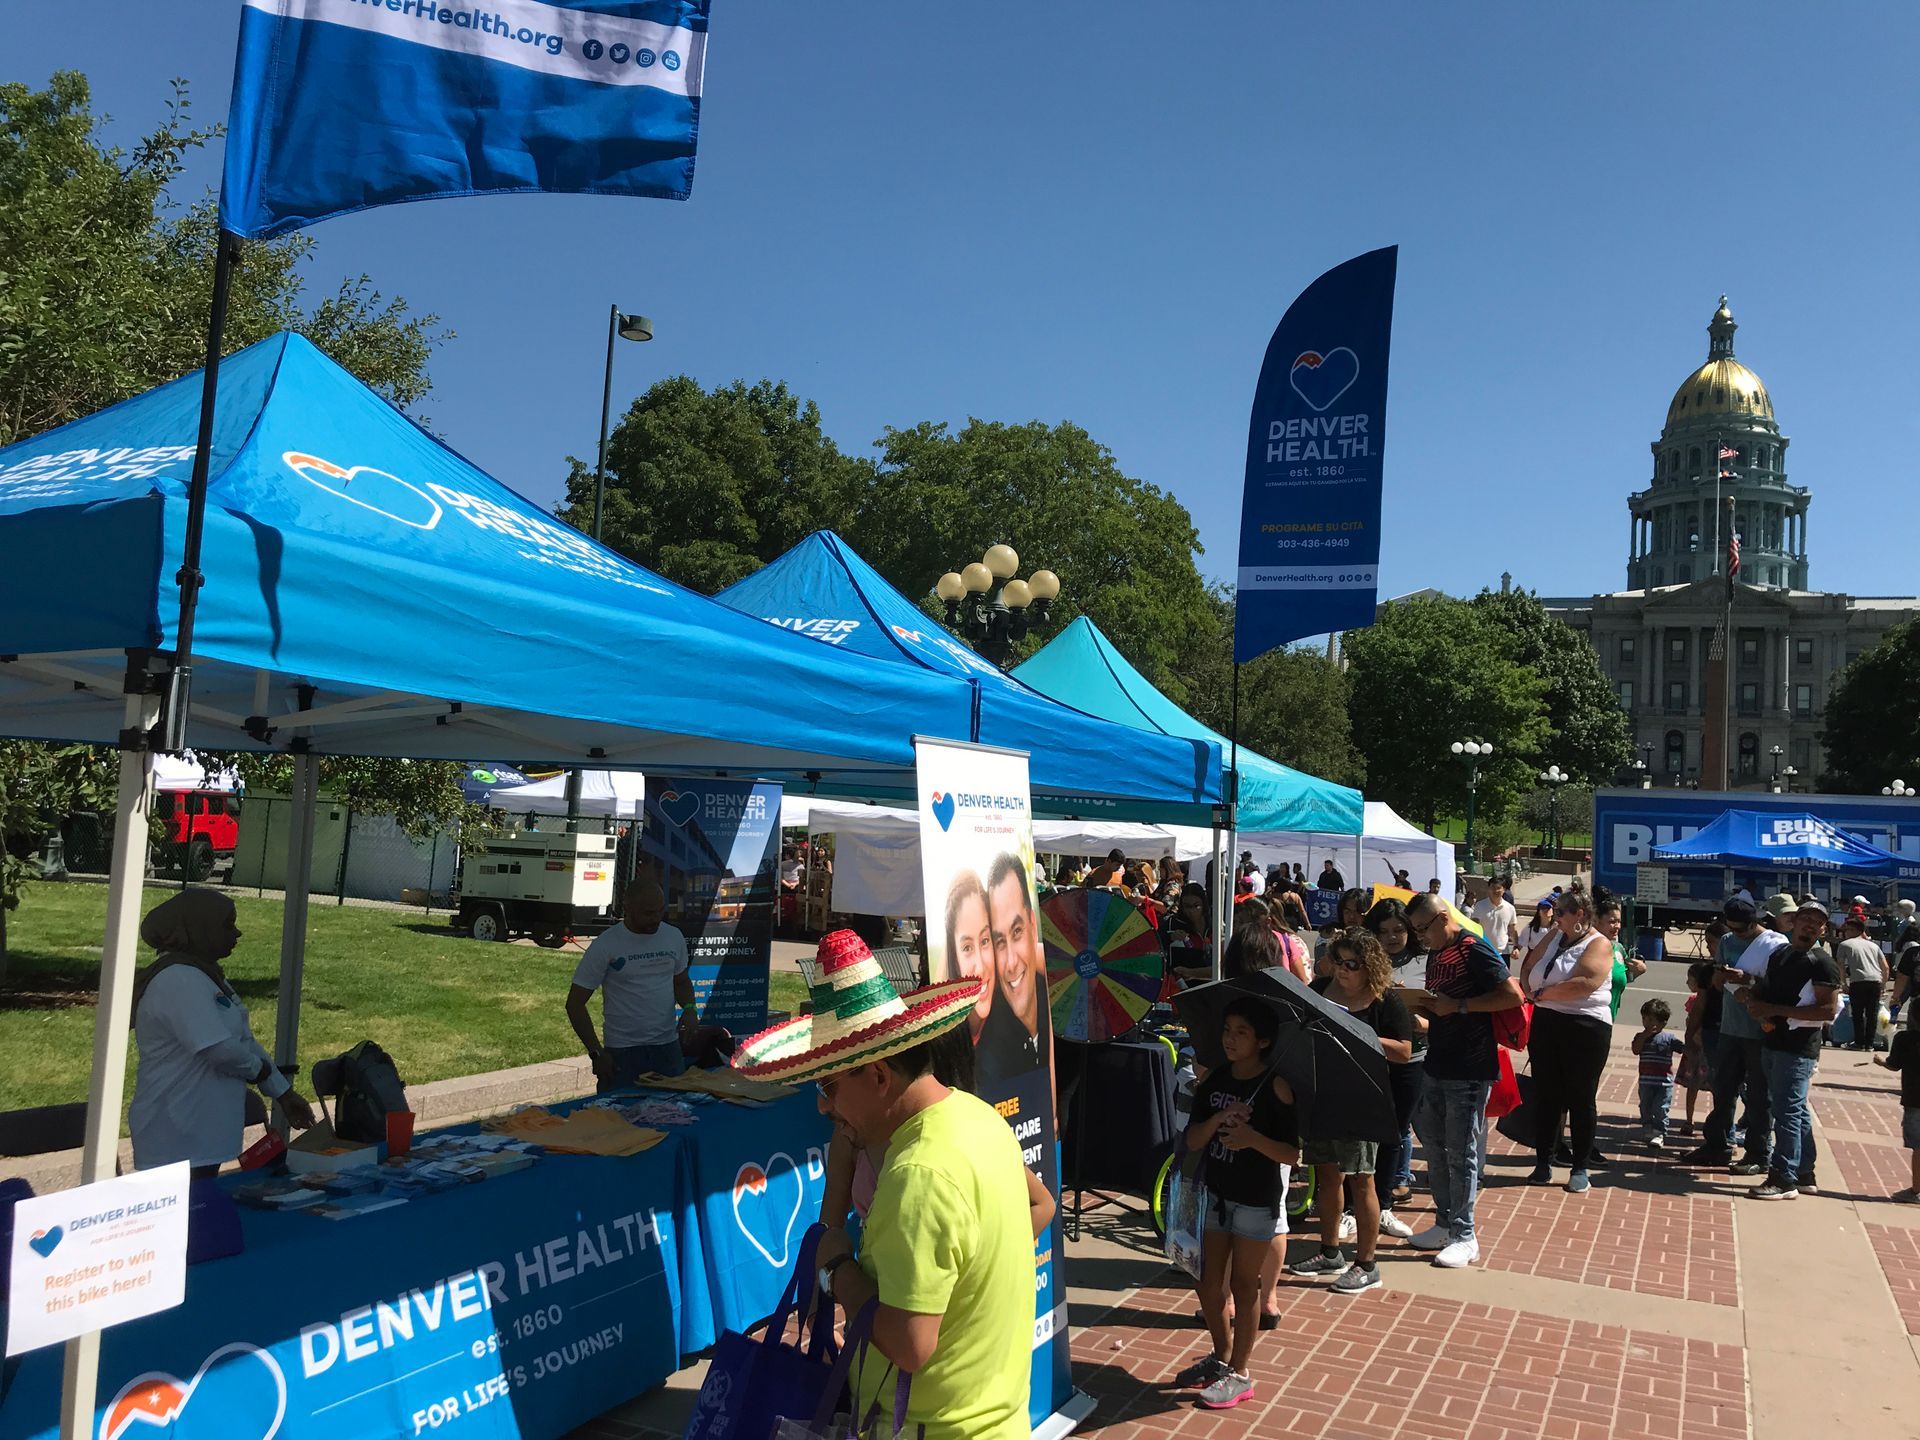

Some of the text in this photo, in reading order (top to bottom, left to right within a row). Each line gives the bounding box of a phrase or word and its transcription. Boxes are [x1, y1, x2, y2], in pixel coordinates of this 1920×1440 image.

[1269, 414, 1369, 440] DENVER
[1267, 437, 1369, 463] HEALTH
[0, 463, 177, 481] EALTH
[1289, 465, 1345, 477] est. 1860
[1262, 521, 1365, 533] PROGRAME SU CITA
[1278, 538, 1350, 548] 303-436-4949
[1255, 574, 1334, 583] DenverHealth.org
[705, 793, 766, 807] DENVER
[957, 793, 993, 808] DENVER
[994, 796, 1025, 810] HEALTH
[705, 807, 766, 820] HEALTH
[1773, 857, 1841, 870] BUD LIGHT
[705, 936, 729, 945] WITH
[730, 936, 748, 944] YOU
[994, 1097, 1020, 1118] FREE
[1015, 1117, 1041, 1140] CARE
[70, 1208, 124, 1232] DENVER
[127, 1195, 177, 1217] HEALTH
[44, 1249, 155, 1291] Register to win
[46, 1270, 153, 1314] this bike here!
[300, 1207, 662, 1379] DENVER HEALTH
[471, 1304, 563, 1359] est. 1860
[413, 1323, 625, 1437] FOR LIFE'S JOURNEY
